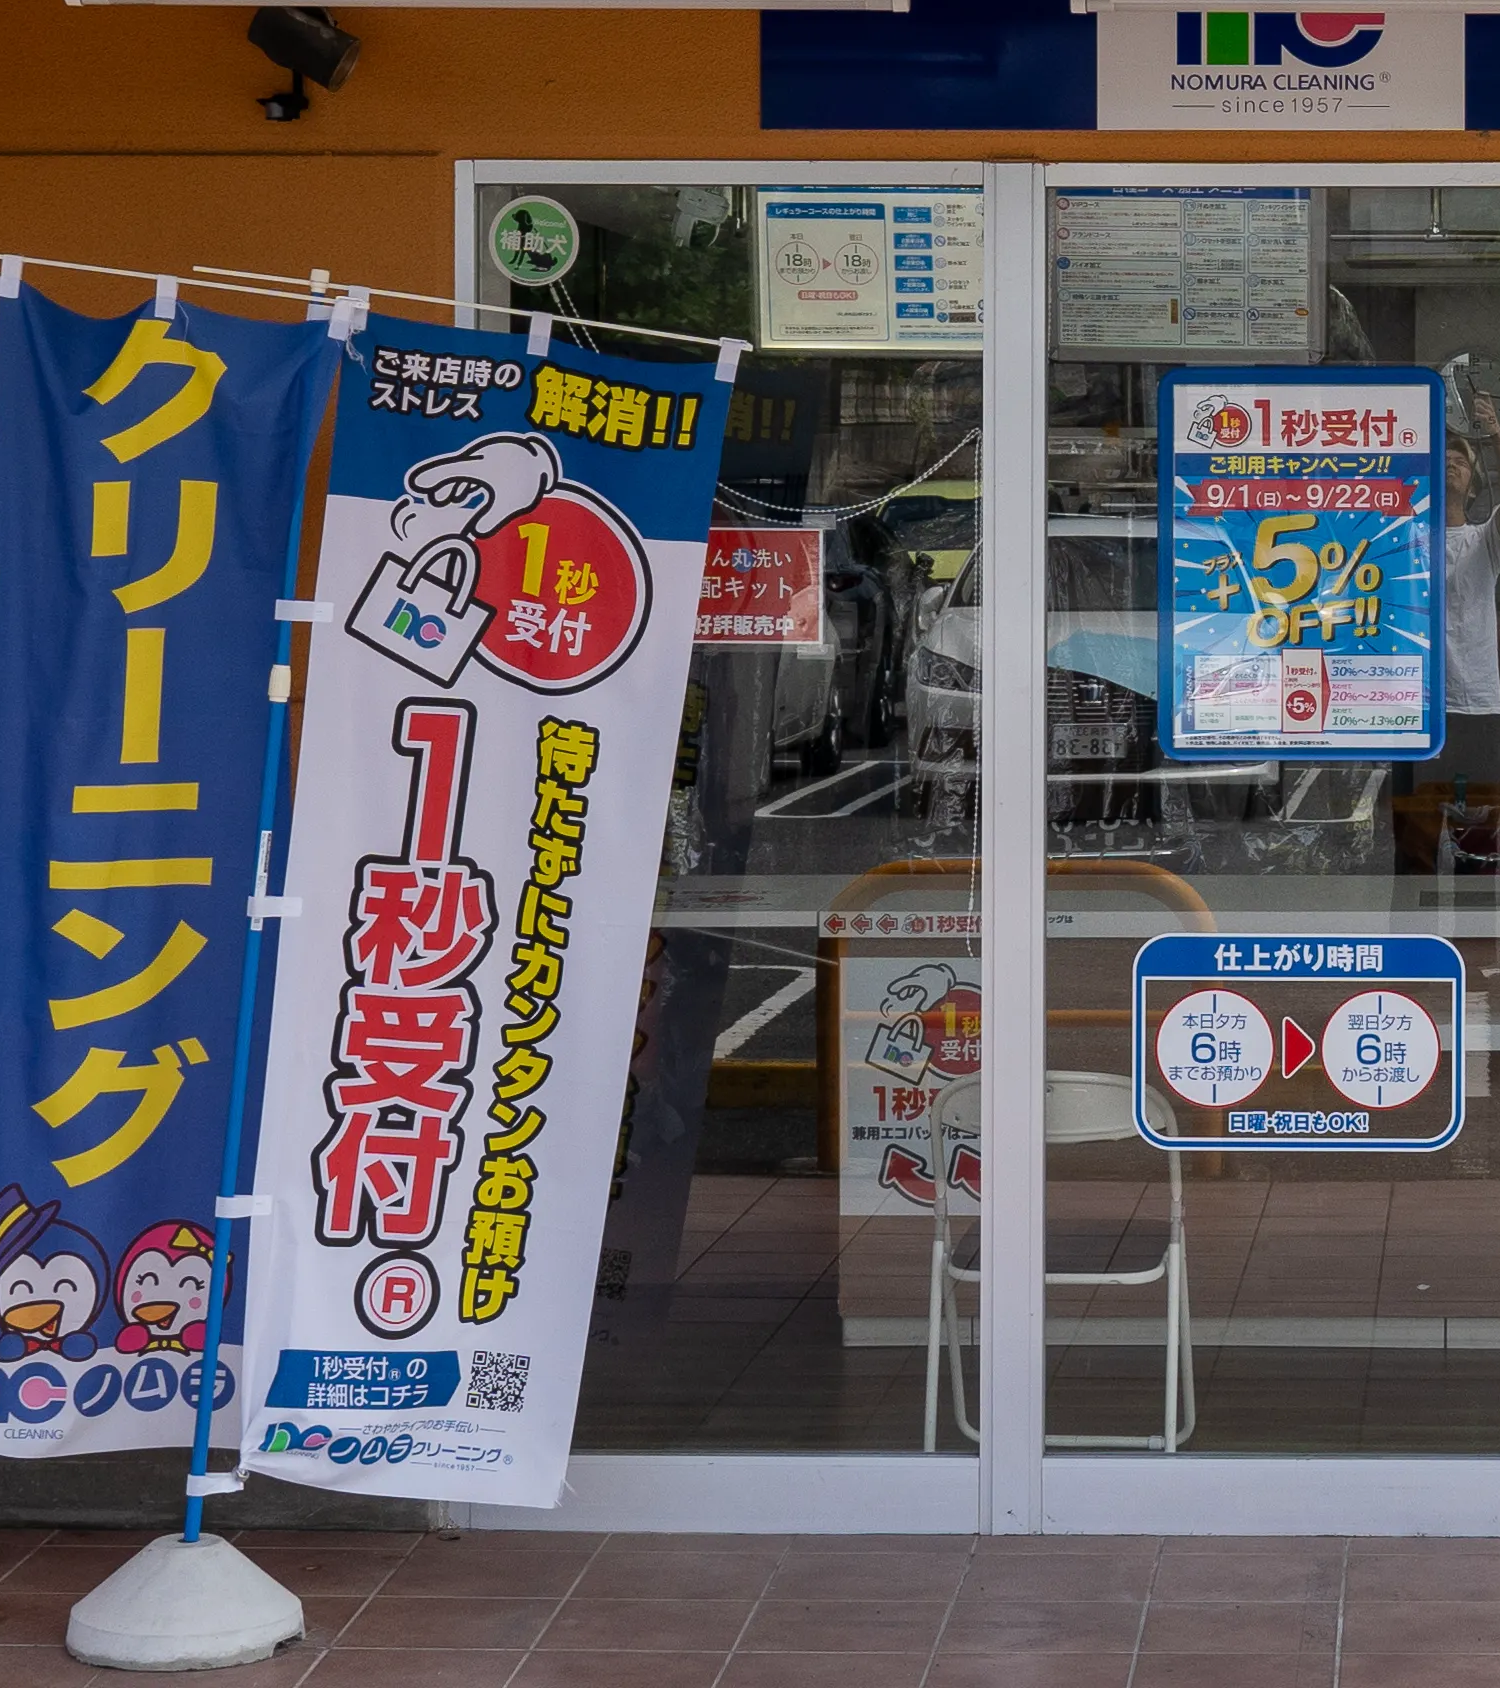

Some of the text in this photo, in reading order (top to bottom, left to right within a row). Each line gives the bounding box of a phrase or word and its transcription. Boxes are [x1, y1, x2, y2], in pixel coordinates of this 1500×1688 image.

[1171, 73, 1267, 91] NOMURA
[1273, 73, 1375, 91] CLEANING
[500, 230, 567, 255] 補助犬
[375, 348, 522, 388] ご来店時の
[371, 381, 481, 419] ストレス
[518, 522, 600, 605] 1秒
[706, 548, 792, 568] ん丸洗い
[1252, 513, 1383, 605] 5%
[505, 599, 592, 656] 受付
[695, 615, 794, 636] 好評販売中
[30, 317, 229, 1190] クリーニング
[1214, 943, 1384, 972] 仕上がり時間
[463, 719, 598, 1319] 待たずにカンタンお預け
[1182, 1013, 1247, 1029] 本日夕方
[1347, 1014, 1413, 1031] 翌日夕方
[1190, 1032, 1242, 1064] 6時
[1355, 1033, 1407, 1065] 6時
[1168, 1065, 1263, 1081] までお預かり
[1342, 1067, 1420, 1083] からお渡し
[306, 1382, 429, 1407] 詳細はコチラ
[3, 1428, 64, 1441] CLEANING
[362, 1419, 480, 1435] さわやかライフのお手伝い
